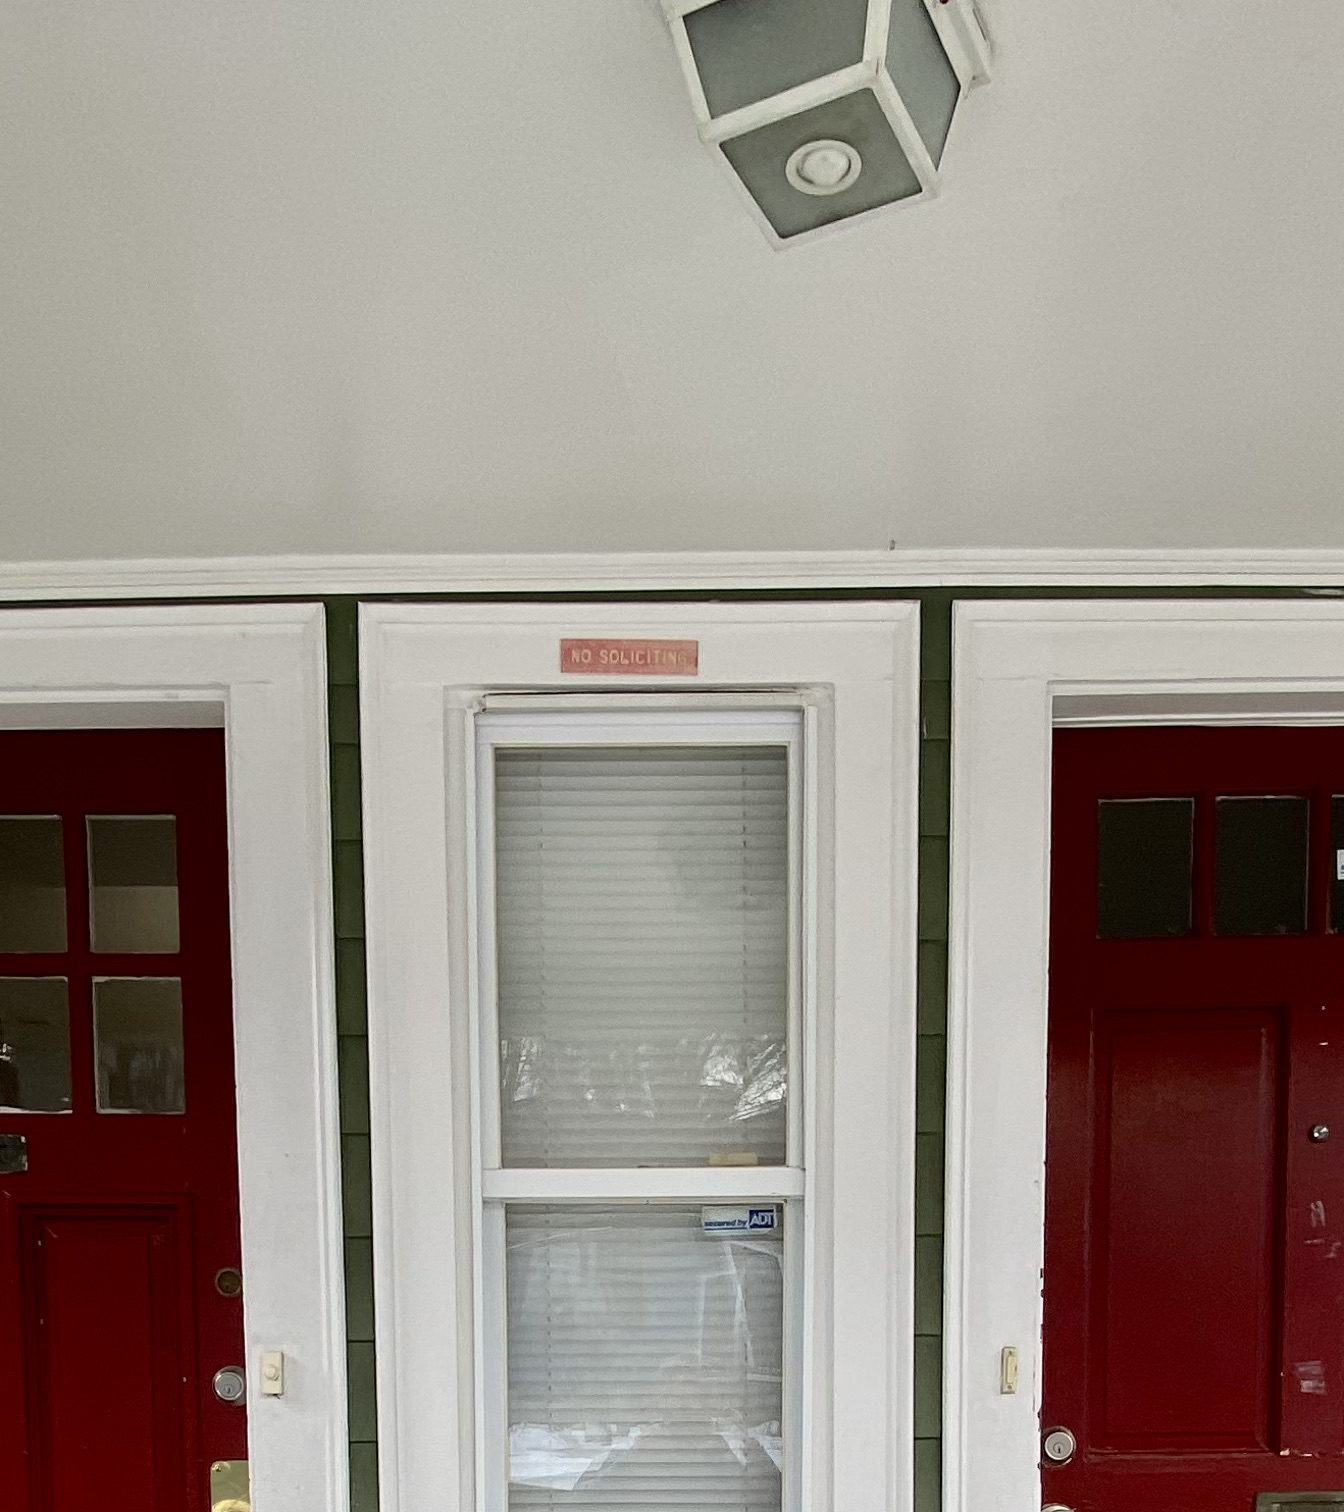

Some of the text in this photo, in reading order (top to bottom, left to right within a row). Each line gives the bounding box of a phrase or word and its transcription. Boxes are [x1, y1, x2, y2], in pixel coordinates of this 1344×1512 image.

[571, 649, 687, 665] NO SOLICITING
[750, 1212, 774, 1226] ADT
